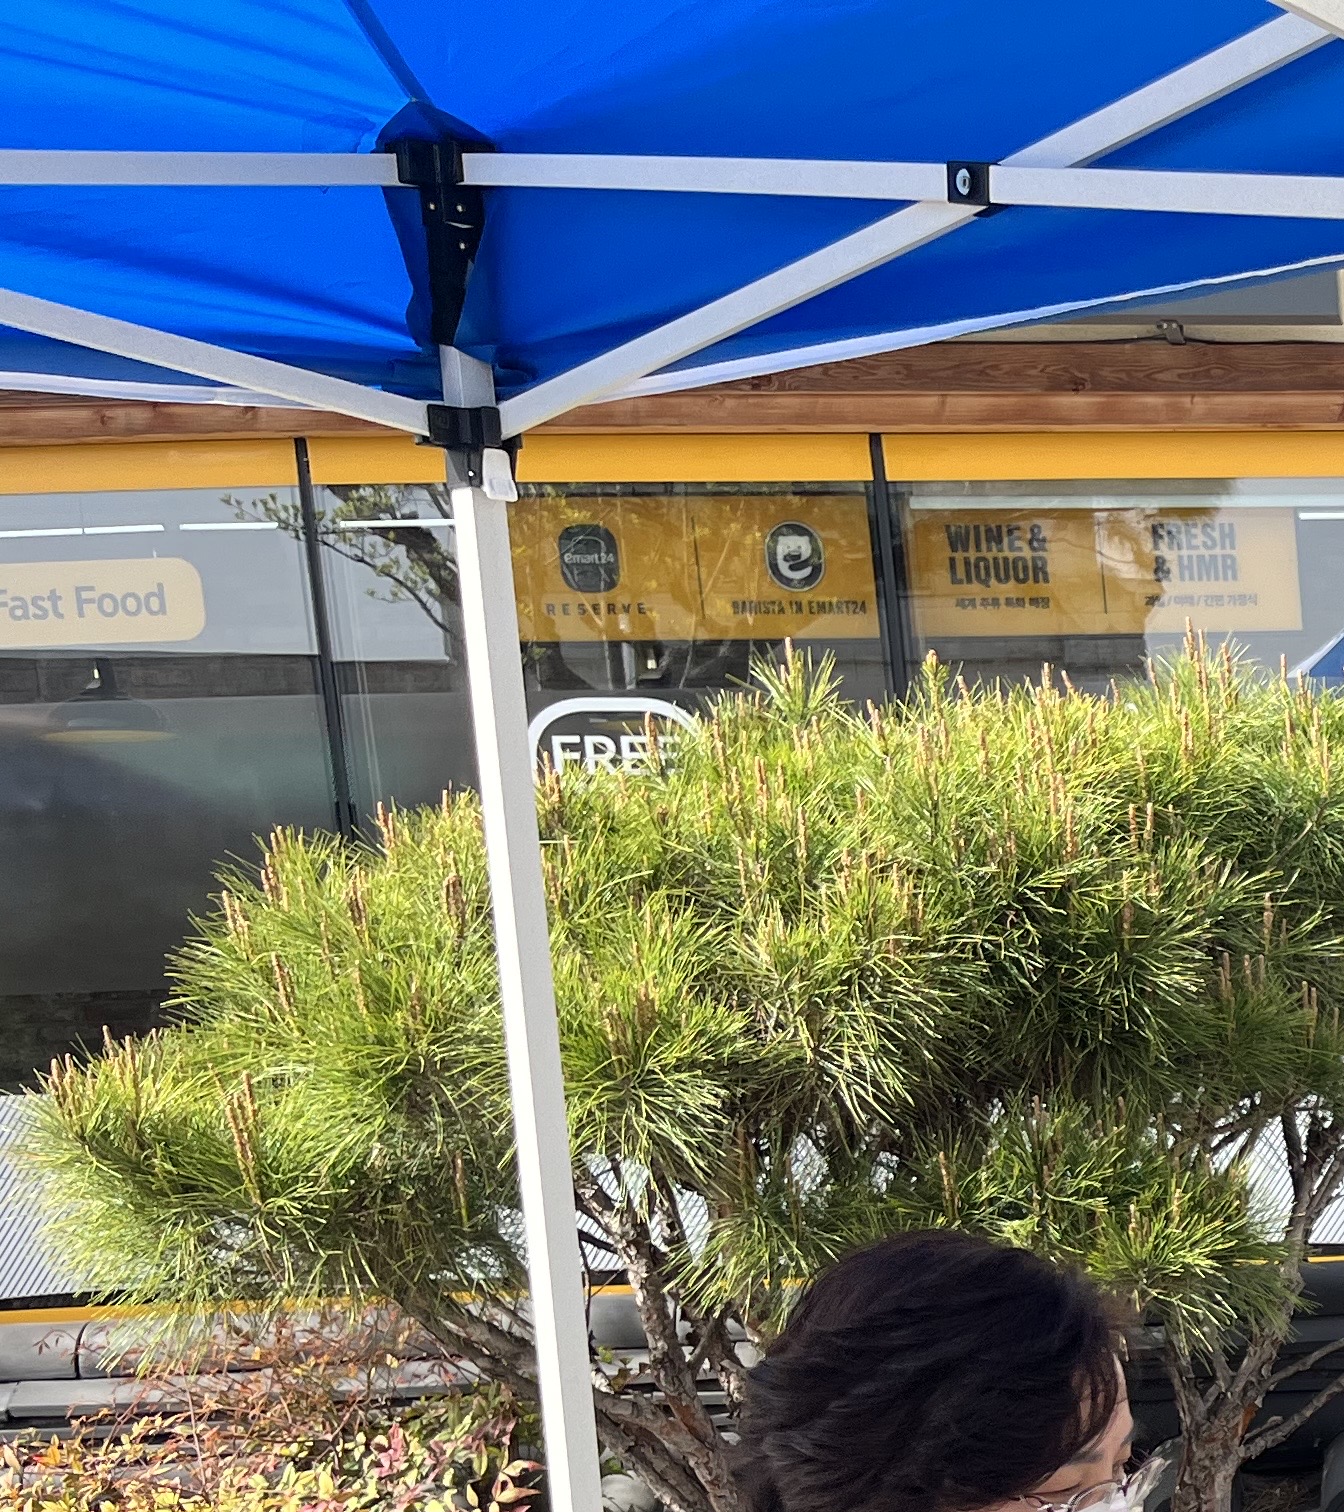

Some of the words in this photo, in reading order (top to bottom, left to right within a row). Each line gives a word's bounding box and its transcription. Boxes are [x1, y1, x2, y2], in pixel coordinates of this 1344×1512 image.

[945, 523, 1023, 554] WINE
[1027, 523, 1049, 553] &
[1151, 522, 1237, 552] FRESH
[564, 551, 616, 566] emart24
[949, 555, 1051, 588] LIQUOR
[1153, 555, 1174, 584] &
[1178, 553, 1239, 583] HMR
[0, 588, 65, 622] Fast
[74, 581, 168, 619] Food
[545, 602, 648, 618] RESERVE
[809, 600, 868, 616] EMART24
